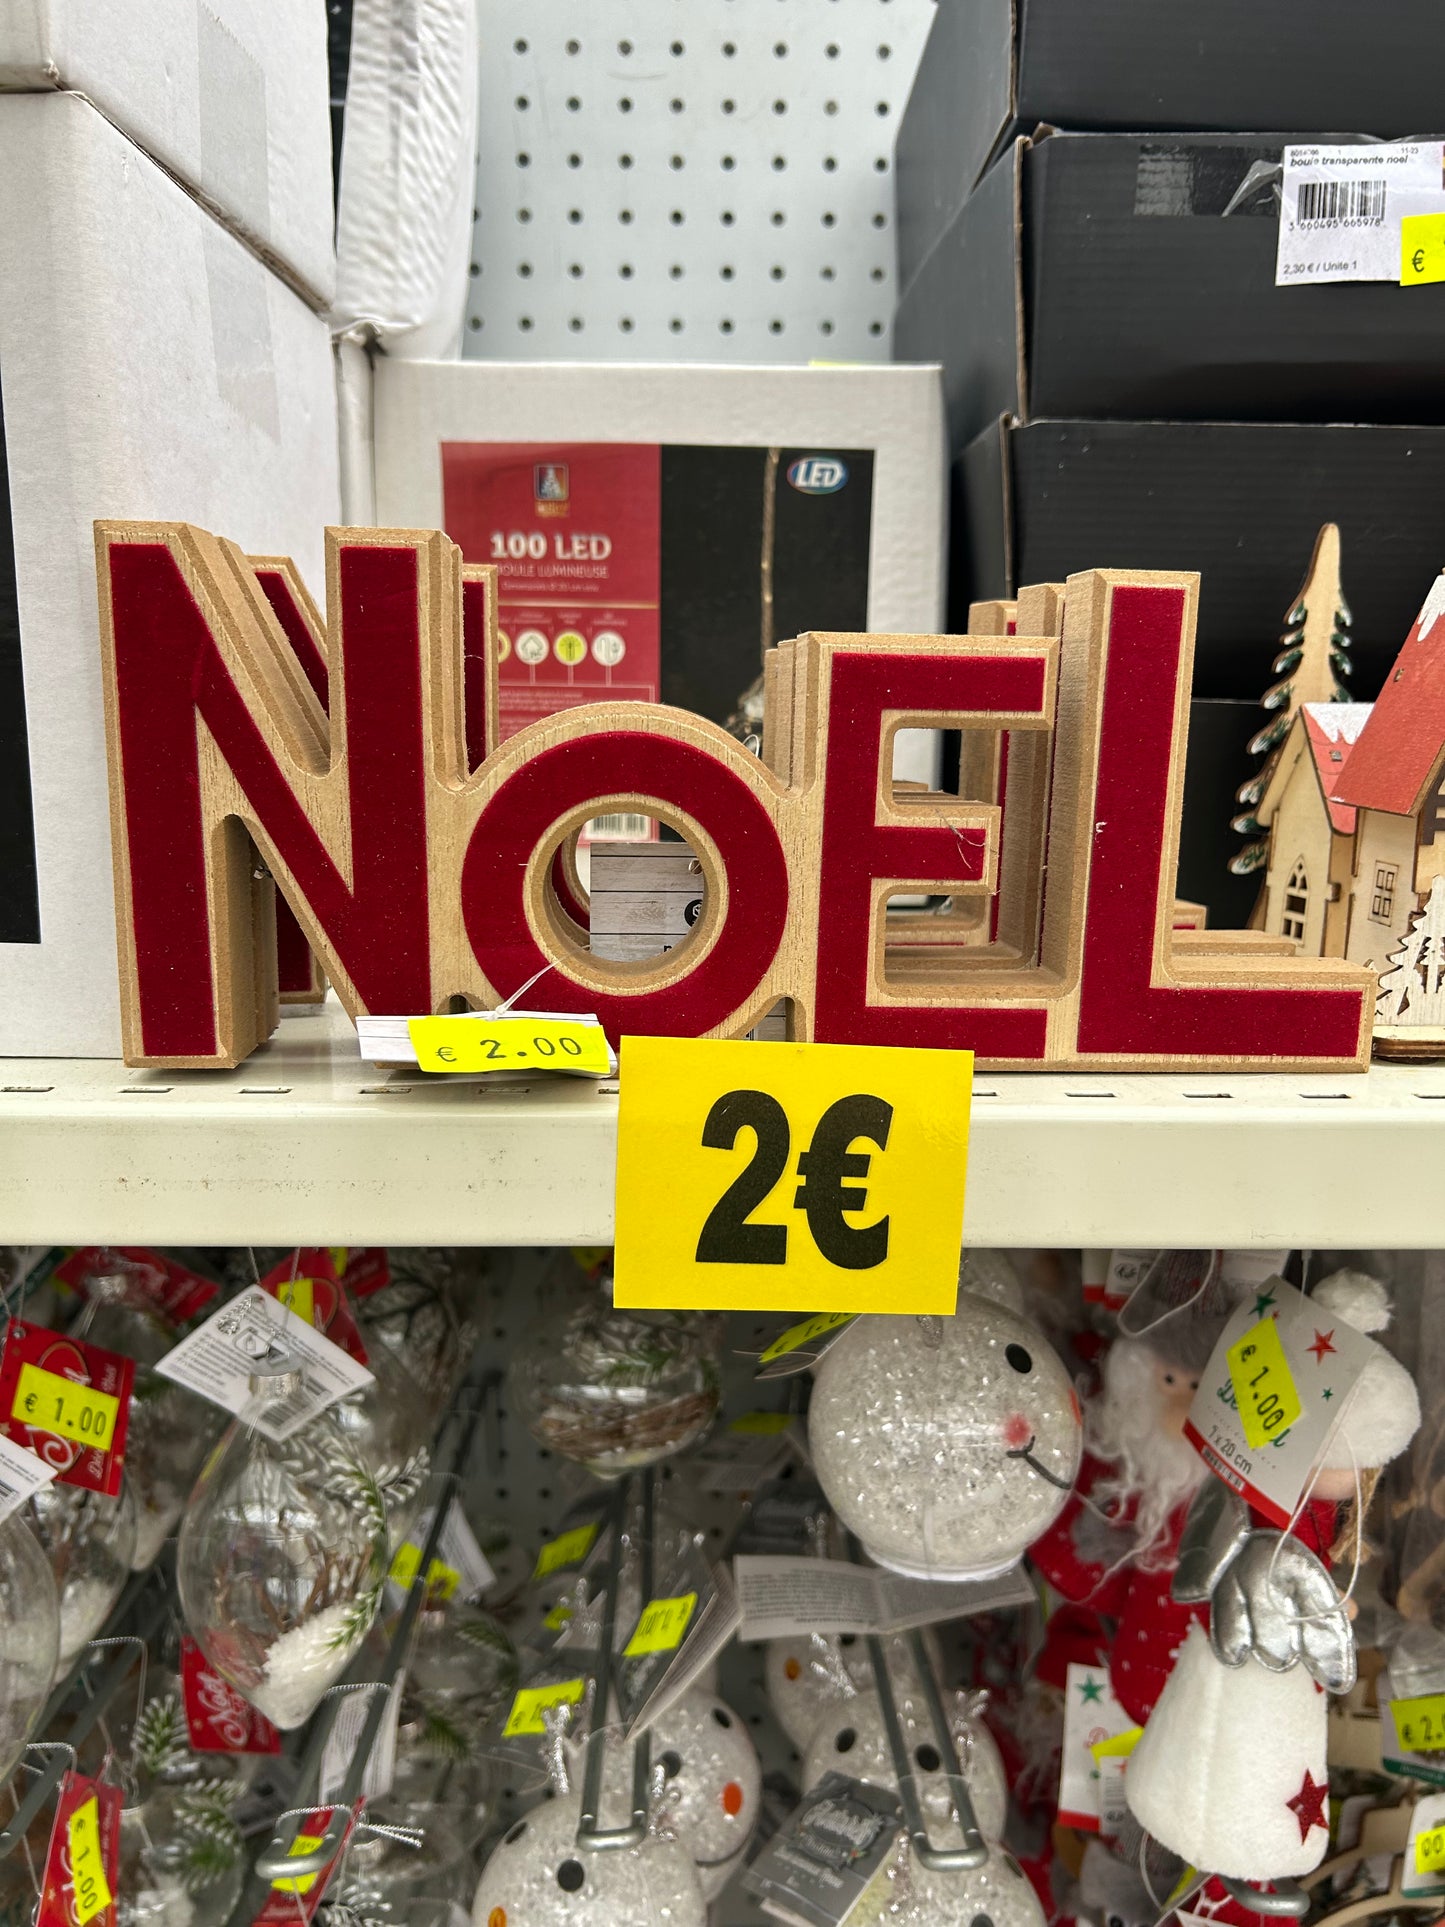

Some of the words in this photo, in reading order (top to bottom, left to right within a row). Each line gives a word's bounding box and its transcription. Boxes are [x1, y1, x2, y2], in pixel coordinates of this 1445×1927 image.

[1321, 155, 1384, 167] transparente
[1300, 220, 1338, 231] 660495
[1343, 219, 1381, 228] 665978
[1411, 249, 1425, 273] €
[794, 461, 844, 488] LED
[490, 532, 547, 559] 100
[554, 532, 612, 560] LED
[435, 1046, 457, 1062] €
[479, 1037, 583, 1060] 2.00
[695, 1089, 894, 1270] 2€
[1240, 1344, 1257, 1363] €
[1249, 1365, 1285, 1431] 1.00
[24, 1393, 38, 1413] €
[54, 1397, 108, 1437] 1.00
[1233, 1454, 1253, 1475] cm
[76, 1847, 98, 1909] 1.00
